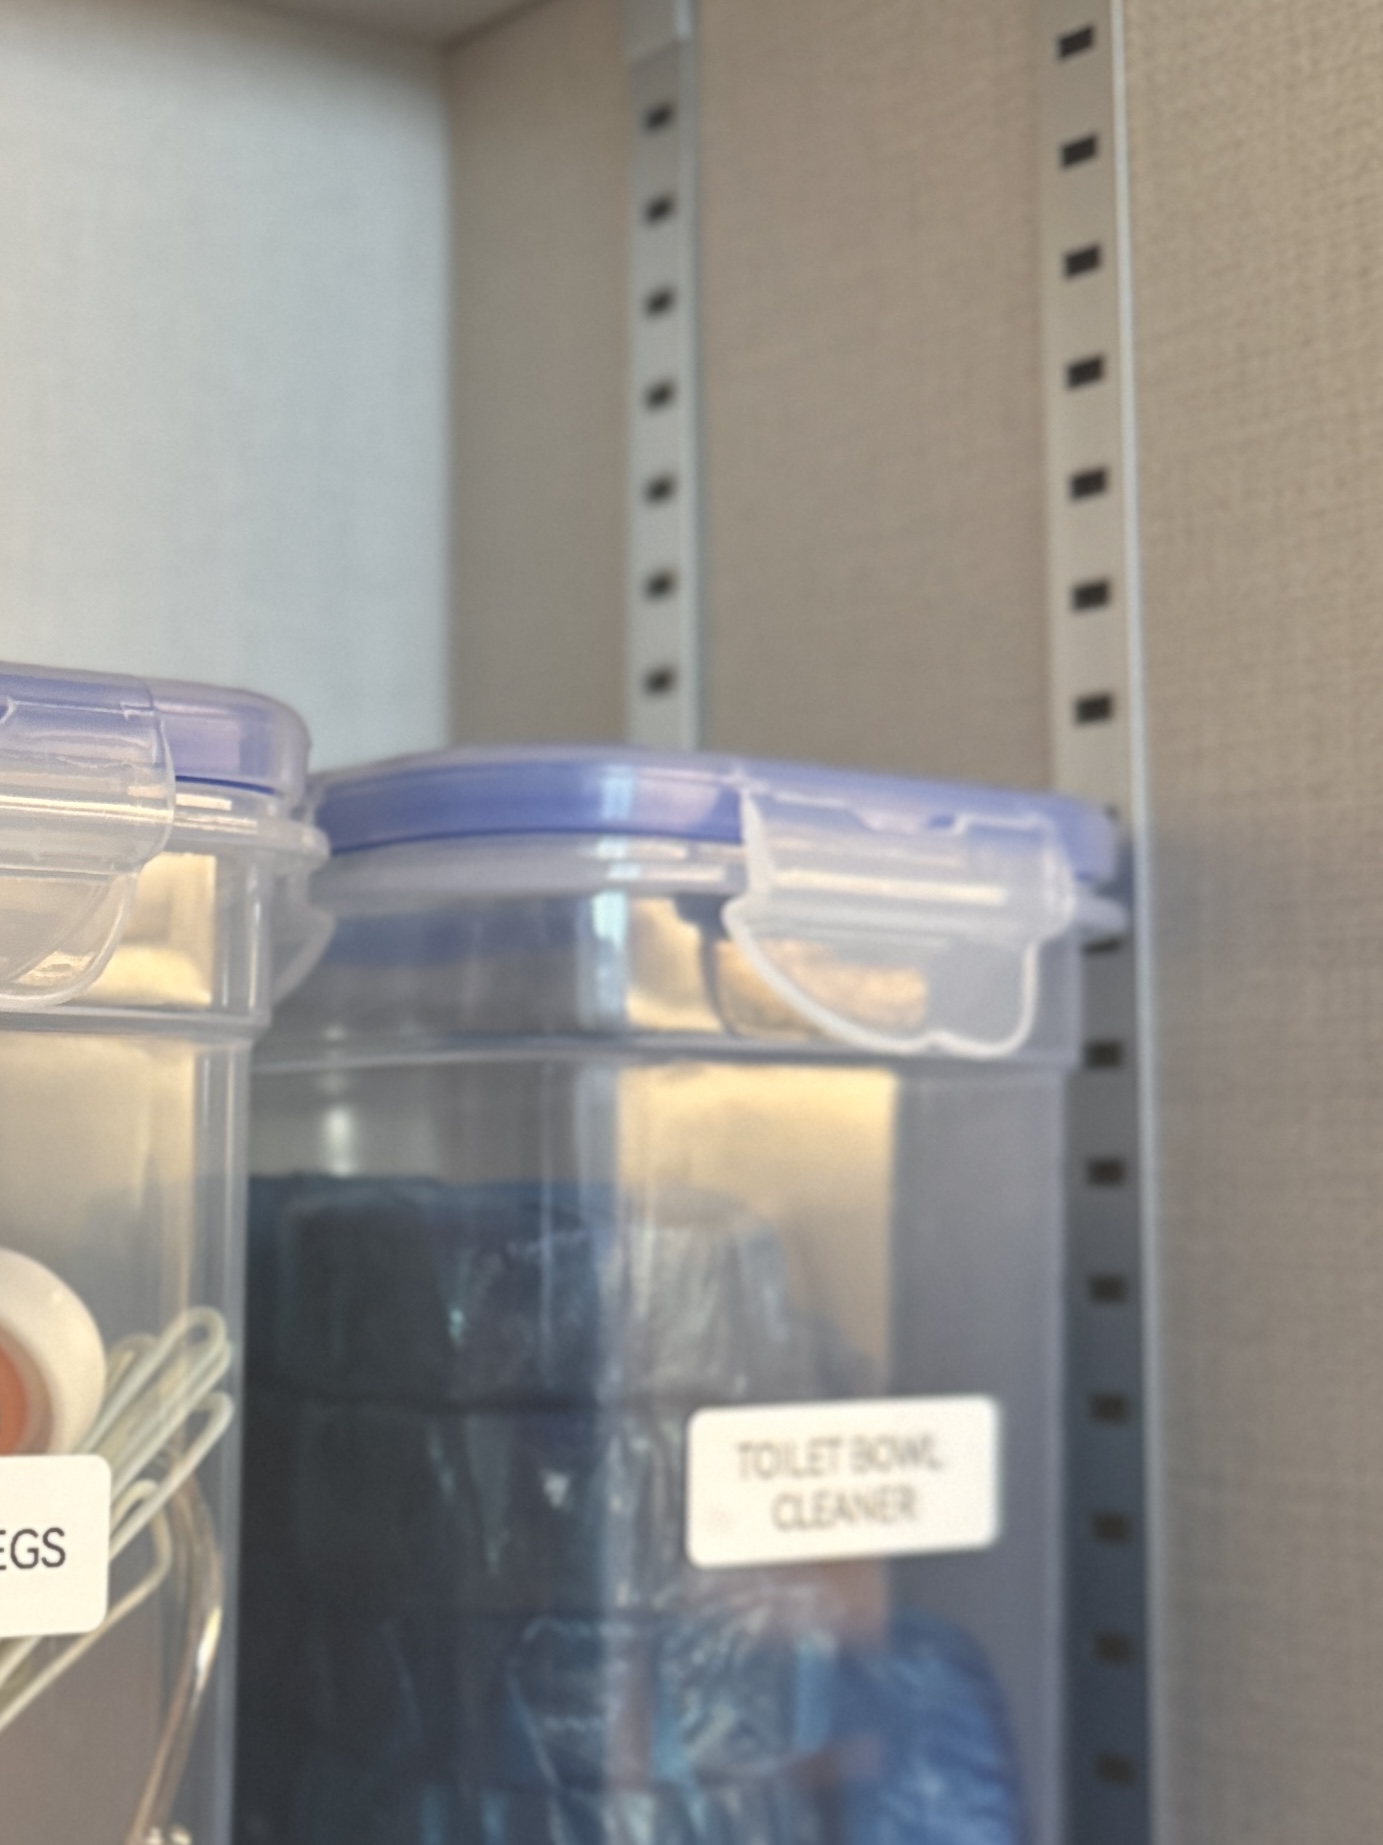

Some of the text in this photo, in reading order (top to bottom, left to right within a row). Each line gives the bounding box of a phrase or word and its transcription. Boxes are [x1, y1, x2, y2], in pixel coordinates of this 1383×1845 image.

[737, 1434, 944, 1481] TOILET BOWL
[770, 1484, 917, 1532] CLEANER
